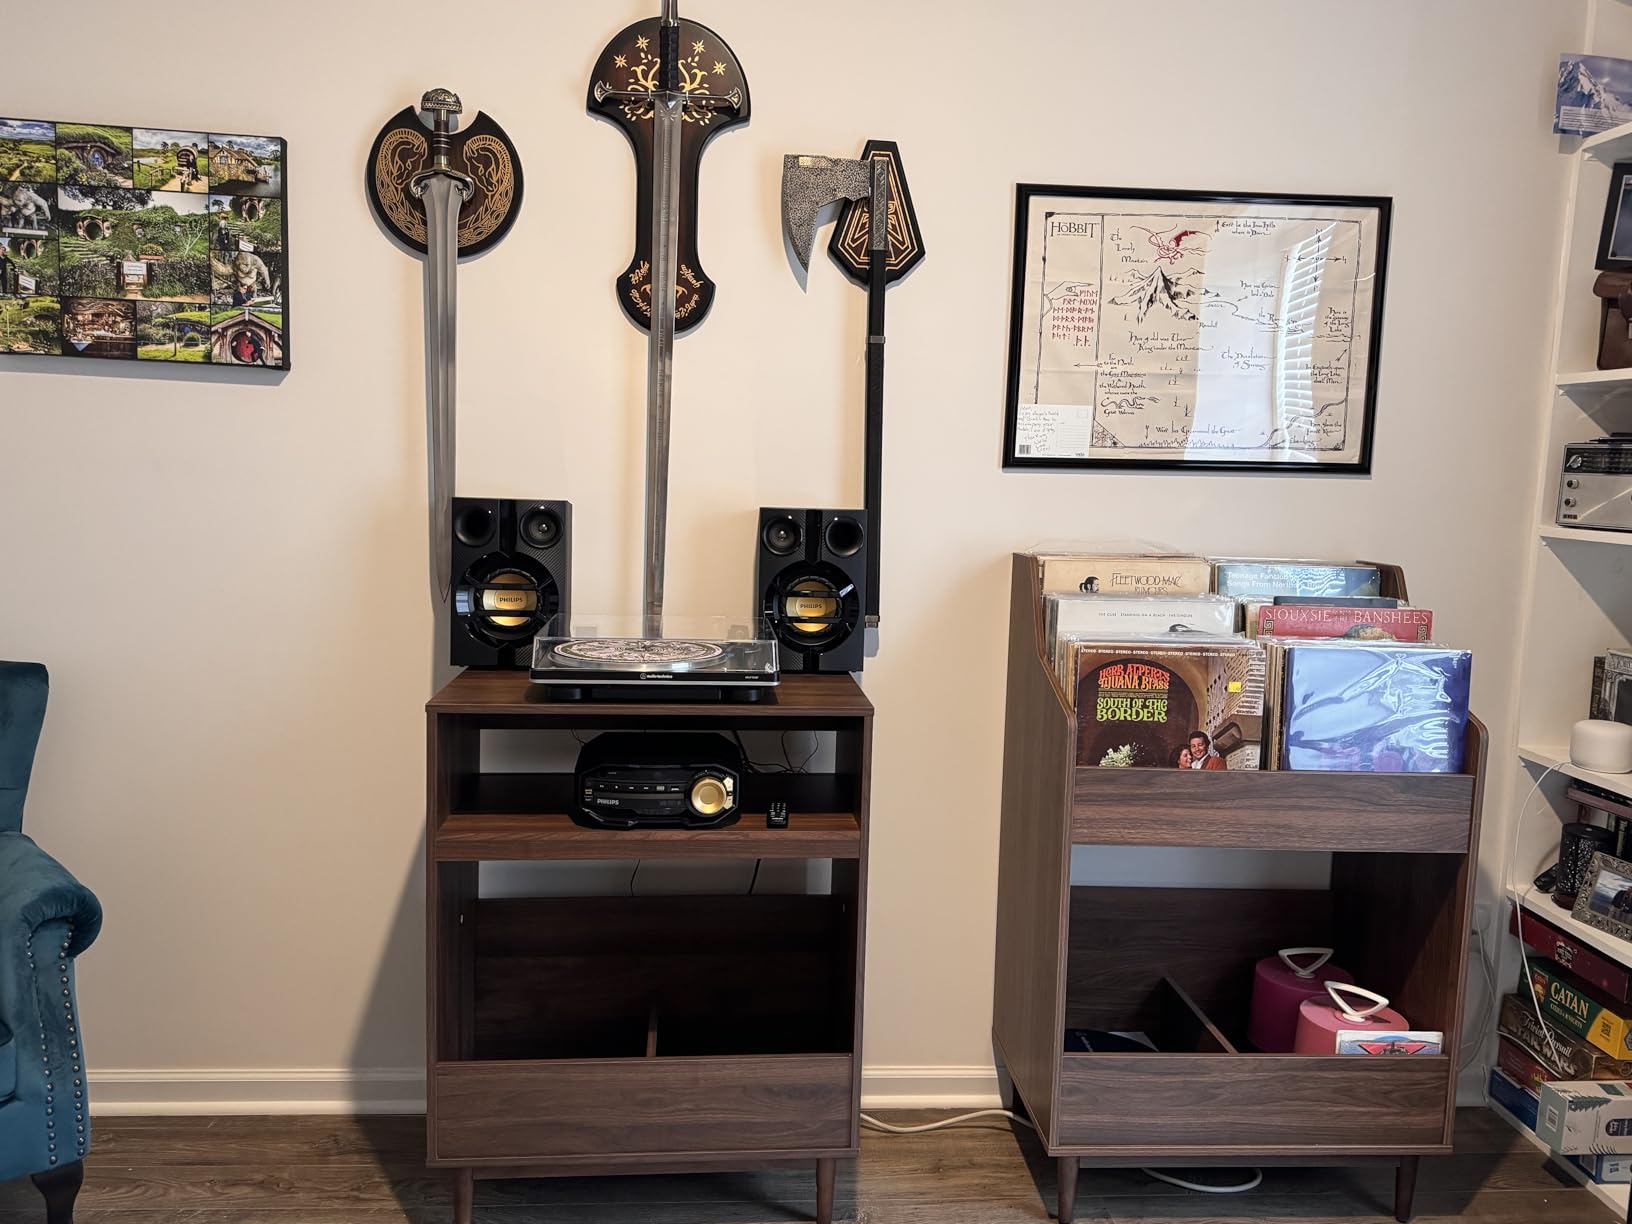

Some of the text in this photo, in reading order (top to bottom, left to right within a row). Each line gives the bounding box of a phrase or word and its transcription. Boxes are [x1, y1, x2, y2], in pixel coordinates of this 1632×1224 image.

[1110, 572, 1160, 587] FLEETWOOD
[1265, 608, 1332, 622] SIOUXSIE
[1354, 610, 1428, 624] BANSHEES
[1097, 697, 1130, 709] SOUTH
[1132, 698, 1144, 709] OF
[1096, 708, 1168, 723] BORDER
[1550, 982, 1589, 1019] CATAN
[1520, 1010, 1545, 1039] Trivial
[1543, 1024, 1572, 1057] Pursuit
